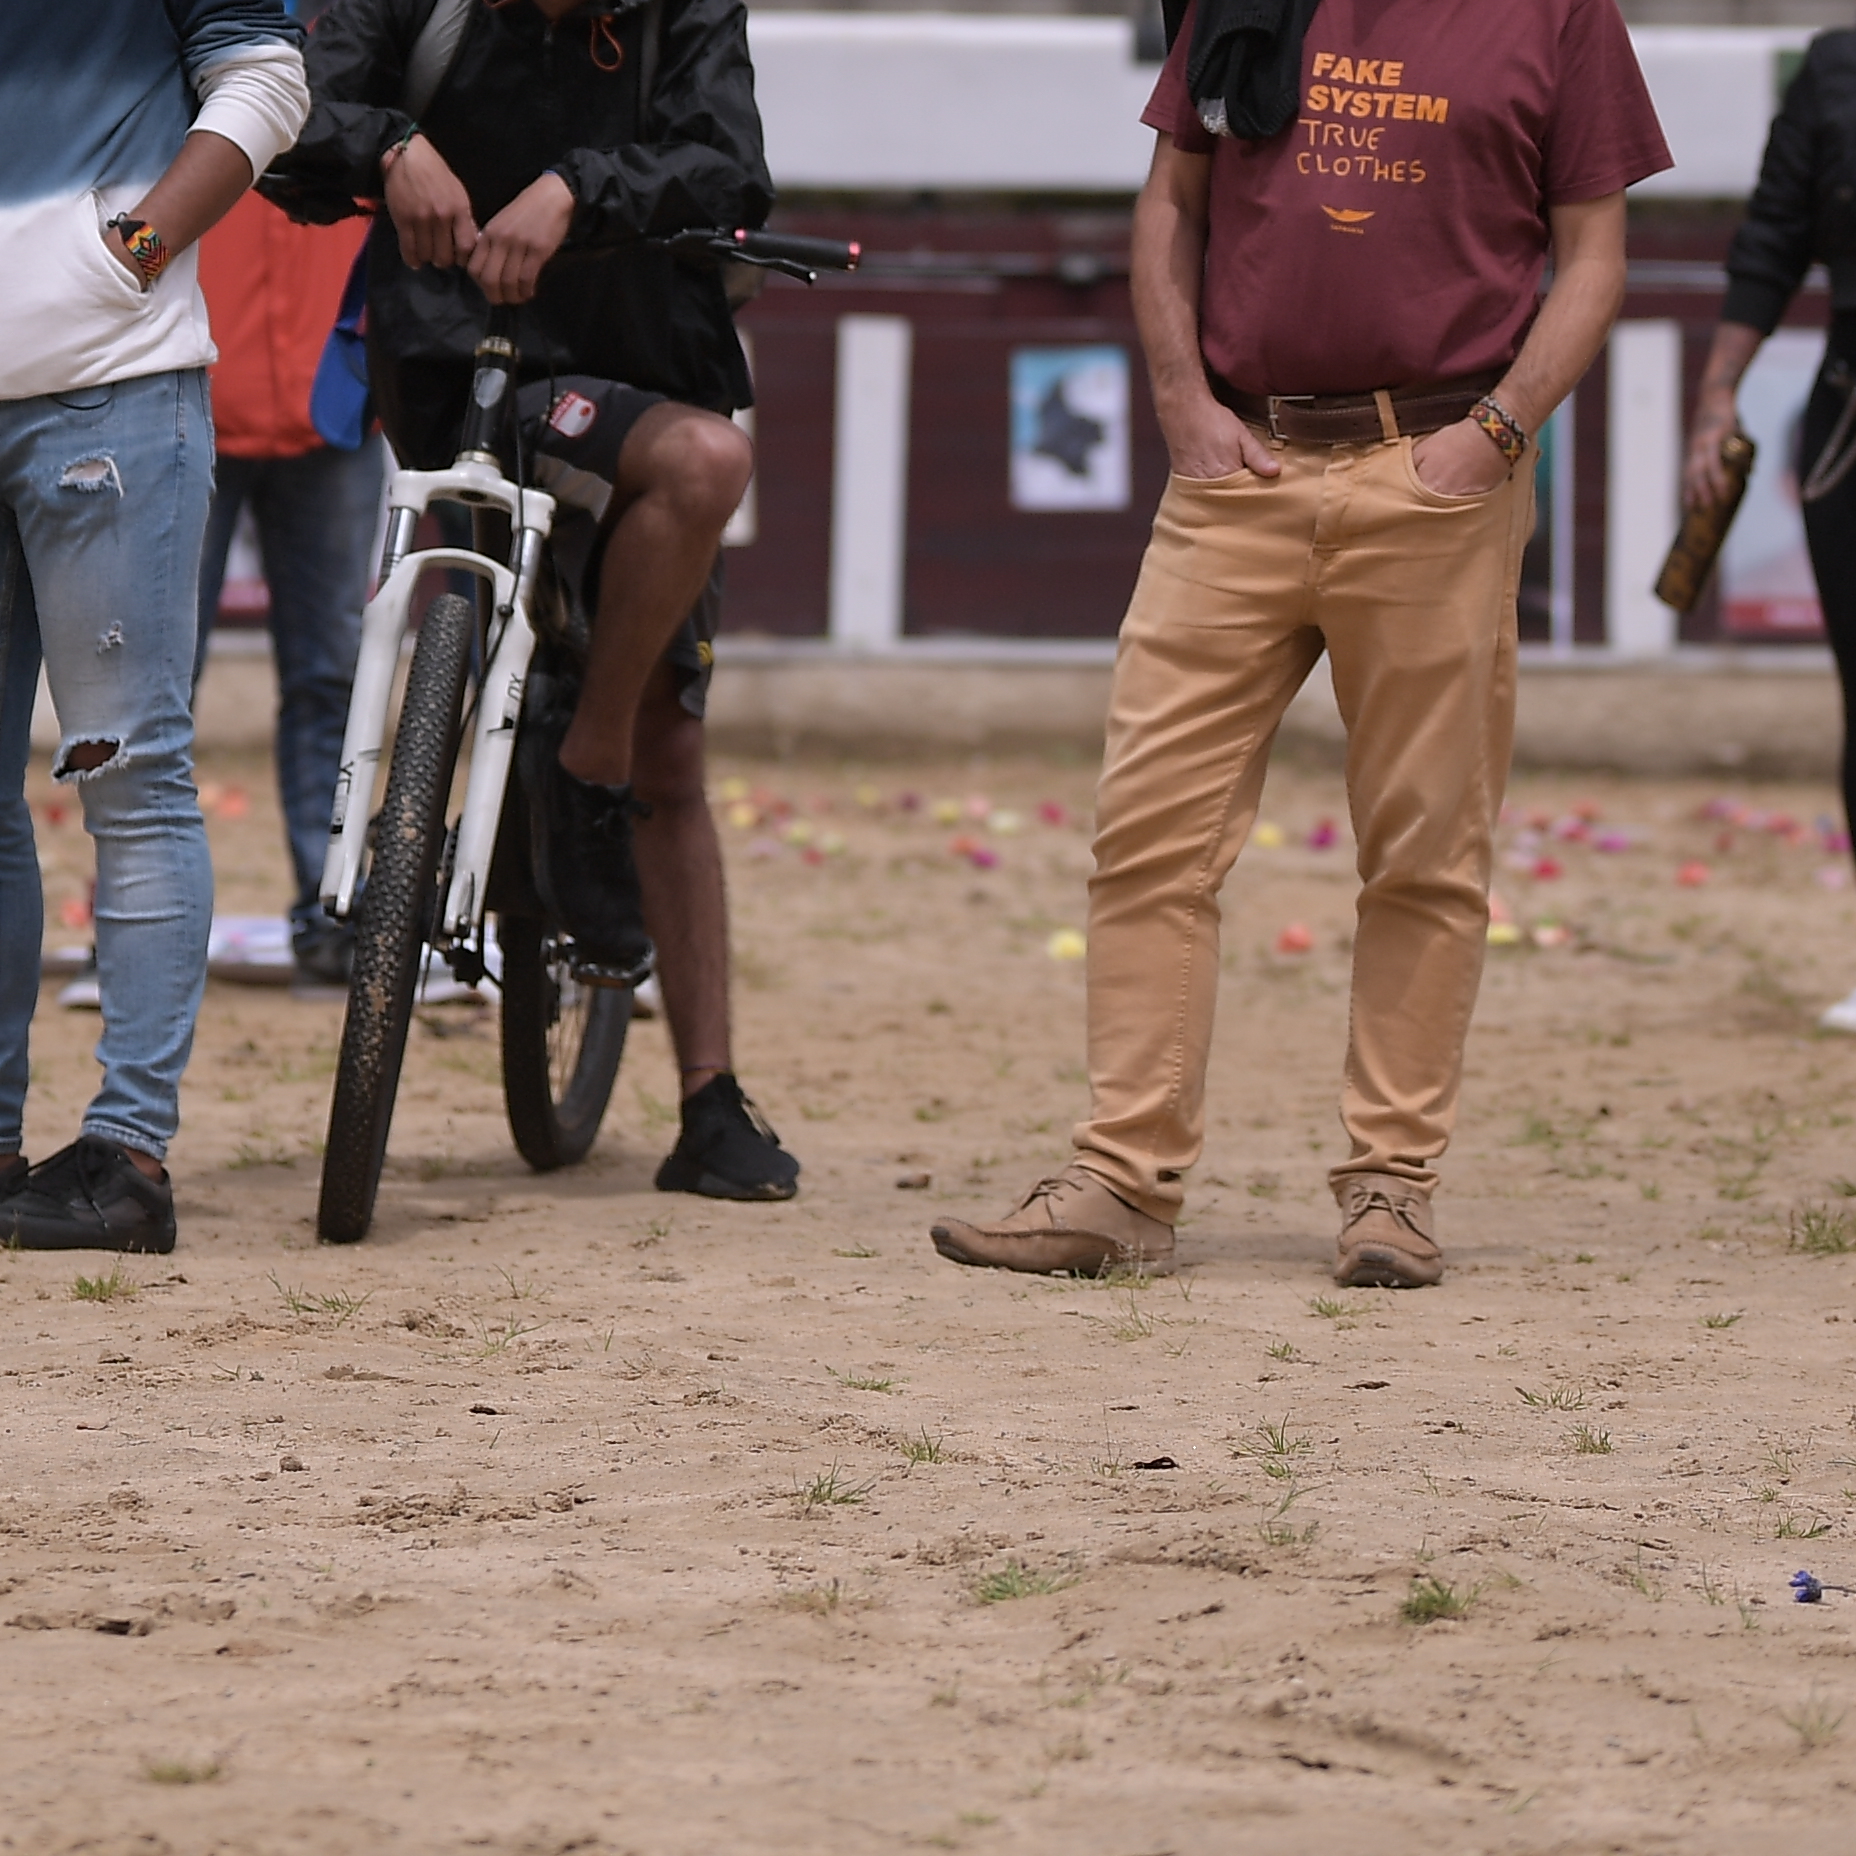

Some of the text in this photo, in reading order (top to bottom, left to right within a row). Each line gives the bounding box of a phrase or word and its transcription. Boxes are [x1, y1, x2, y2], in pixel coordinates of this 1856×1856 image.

[1312, 51, 1405, 87] FAKE
[1306, 83, 1449, 125] SYSTEM
[1298, 118, 1386, 151] TRUE
[1296, 152, 1427, 184] CLOTHES
